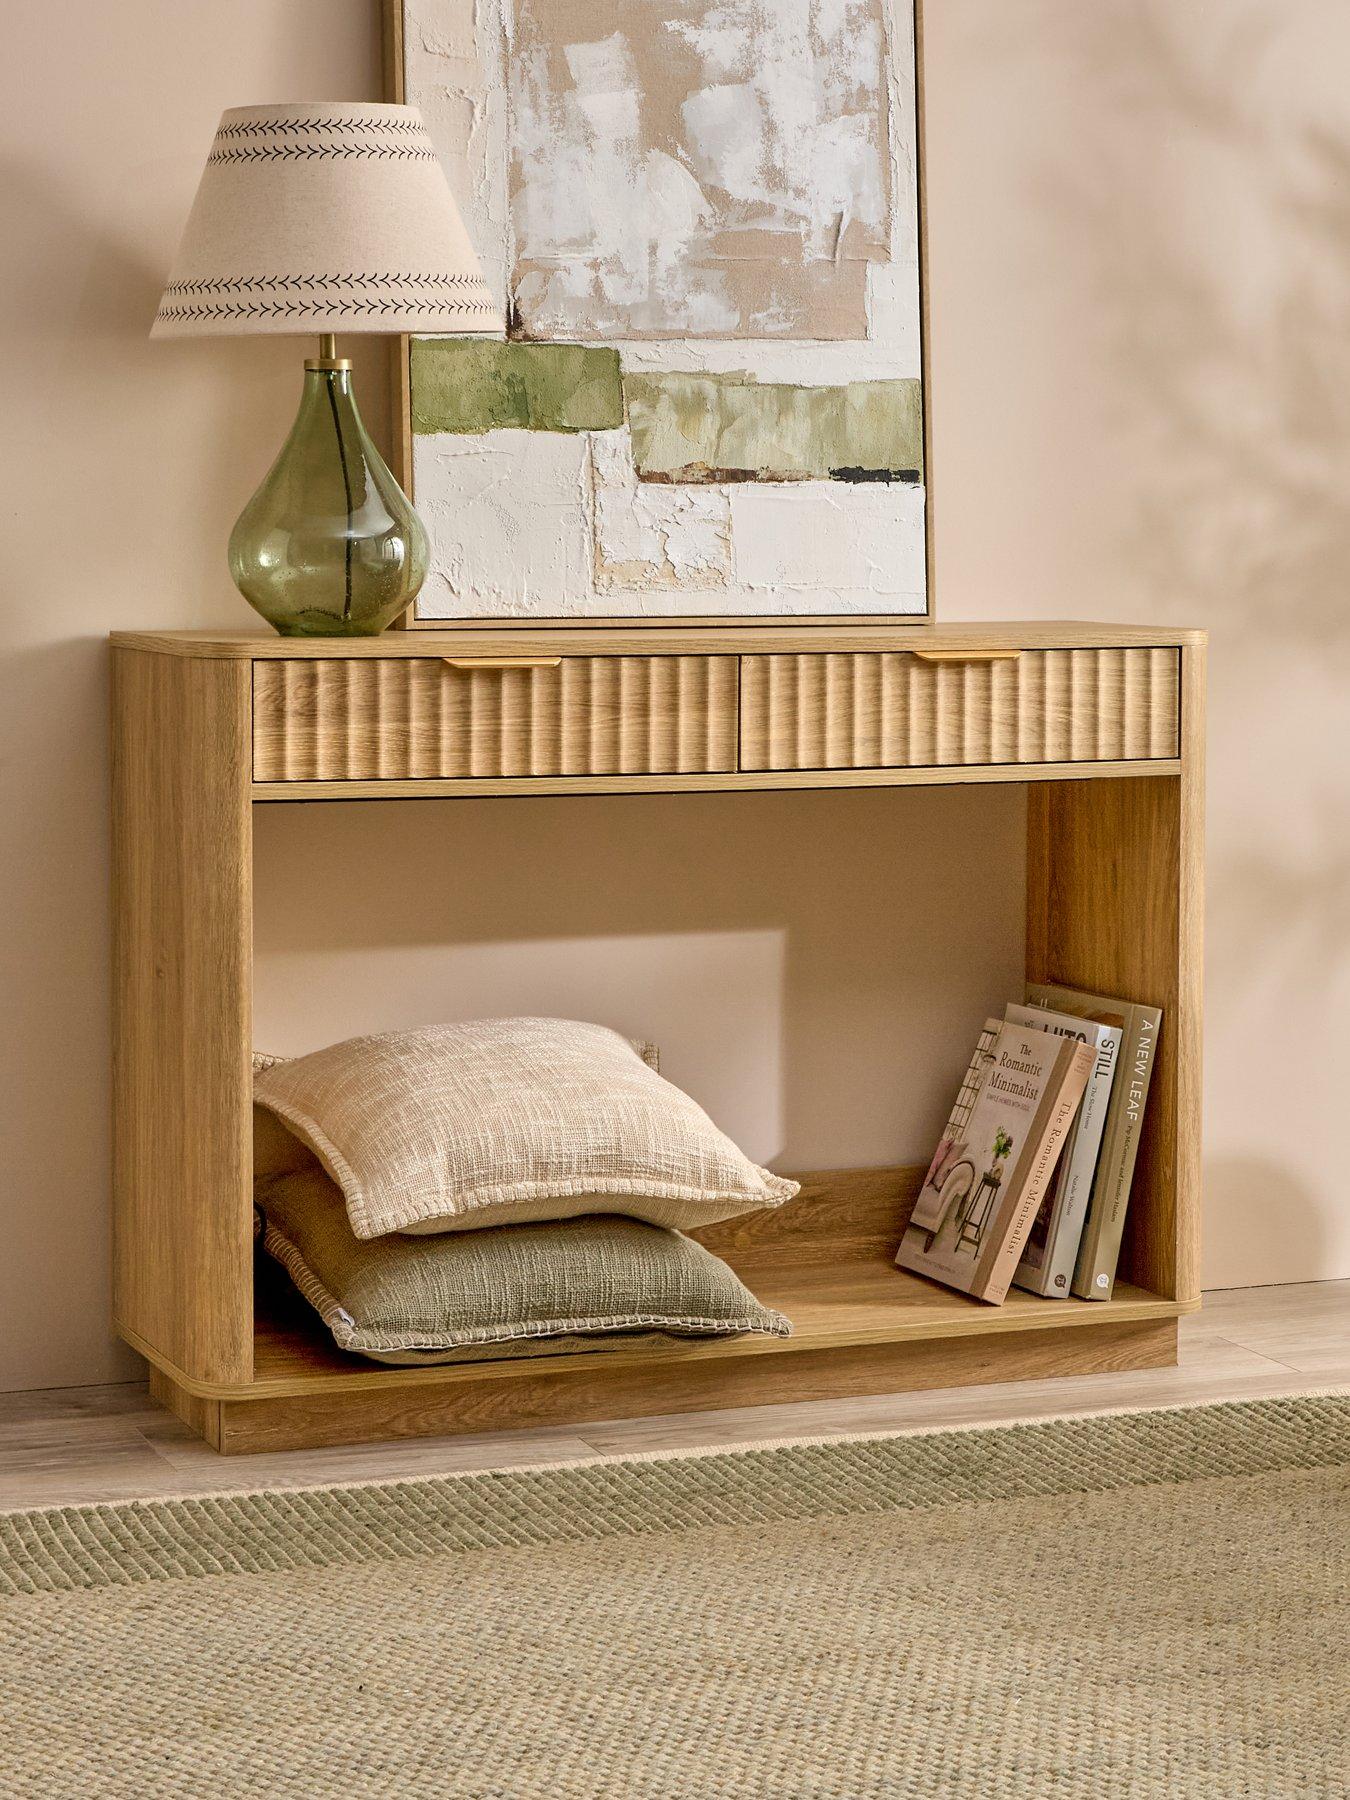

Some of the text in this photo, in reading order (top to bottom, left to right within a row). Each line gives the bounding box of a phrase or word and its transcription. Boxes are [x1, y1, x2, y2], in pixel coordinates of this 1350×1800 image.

[999, 1051, 1042, 1077] Romantic
[1020, 1044, 1032, 1056] The
[1094, 1039, 1115, 1079] STILL
[988, 1071, 1039, 1101] Minimalist
[1126, 1019, 1154, 1121] A NEW LEAF
[1006, 1102, 1072, 1255] The Romantic Minimalist
